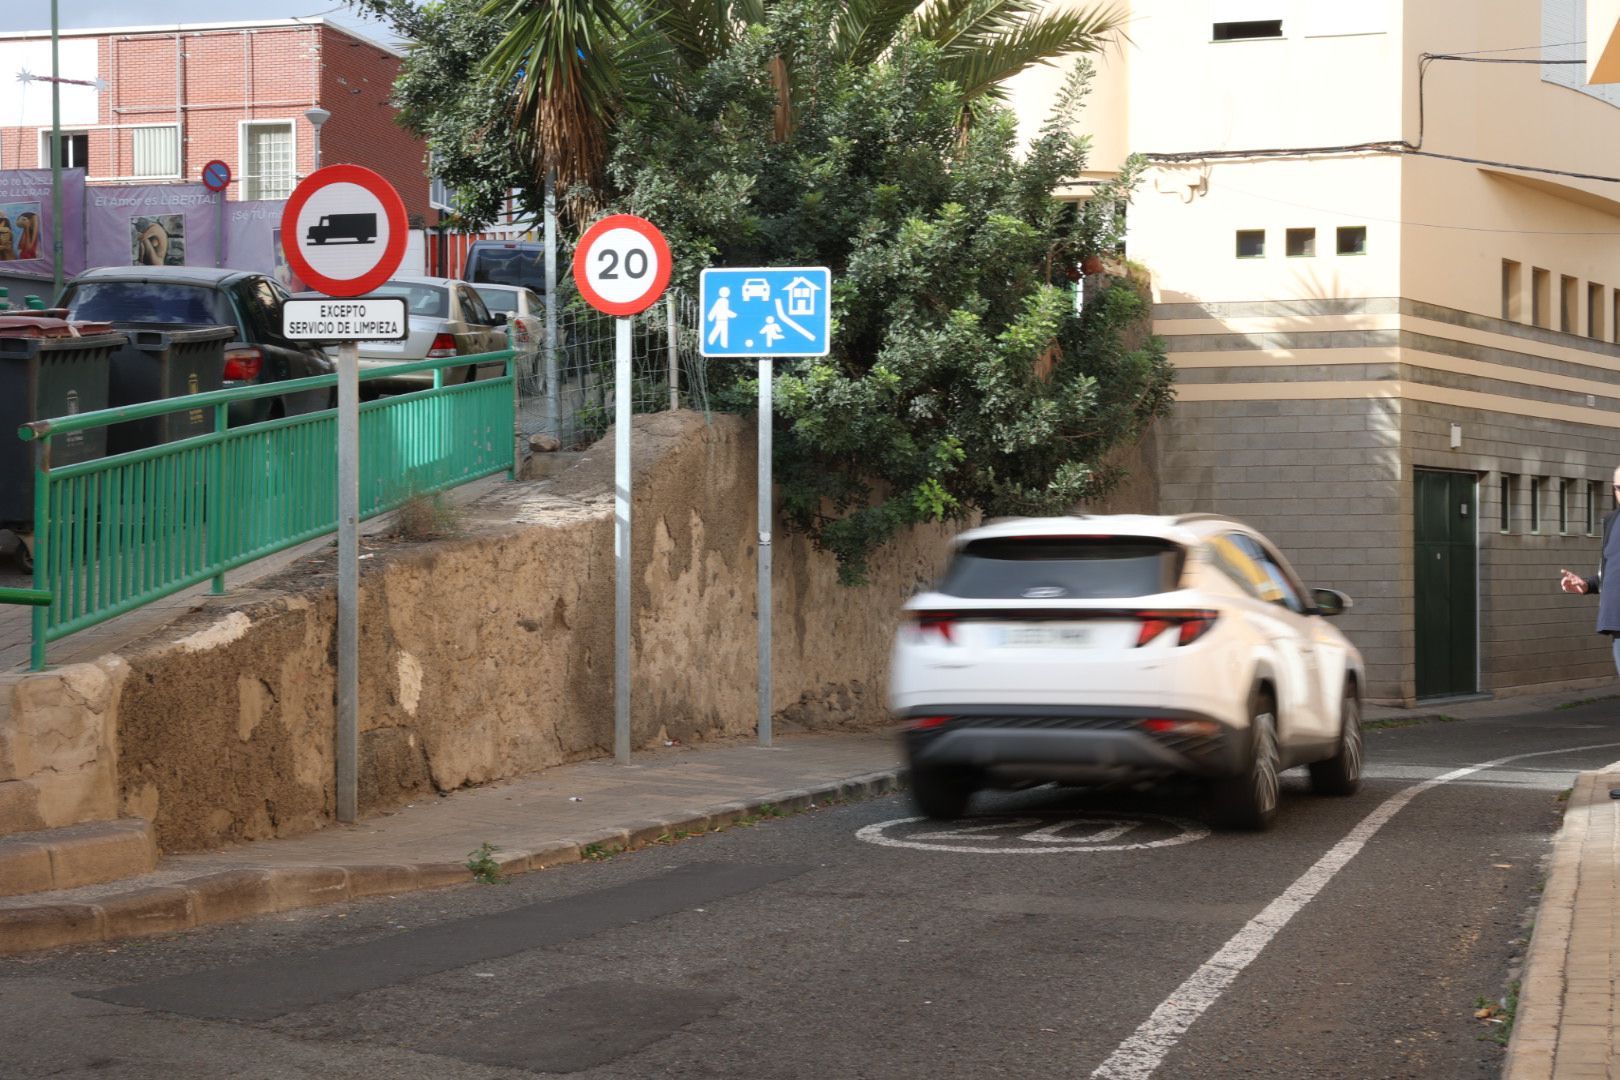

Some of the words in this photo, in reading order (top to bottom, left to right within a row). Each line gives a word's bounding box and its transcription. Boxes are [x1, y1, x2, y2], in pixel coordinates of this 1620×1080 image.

[110, 196, 142, 206] Amor
[145, 196, 158, 205] es
[598, 248, 648, 280] 20
[320, 304, 366, 318] EXCEPTO
[289, 321, 335, 334] SERVICIO
[338, 321, 351, 334] DE
[354, 321, 398, 334] LIMPIEZA
[905, 817, 1144, 843] 20
